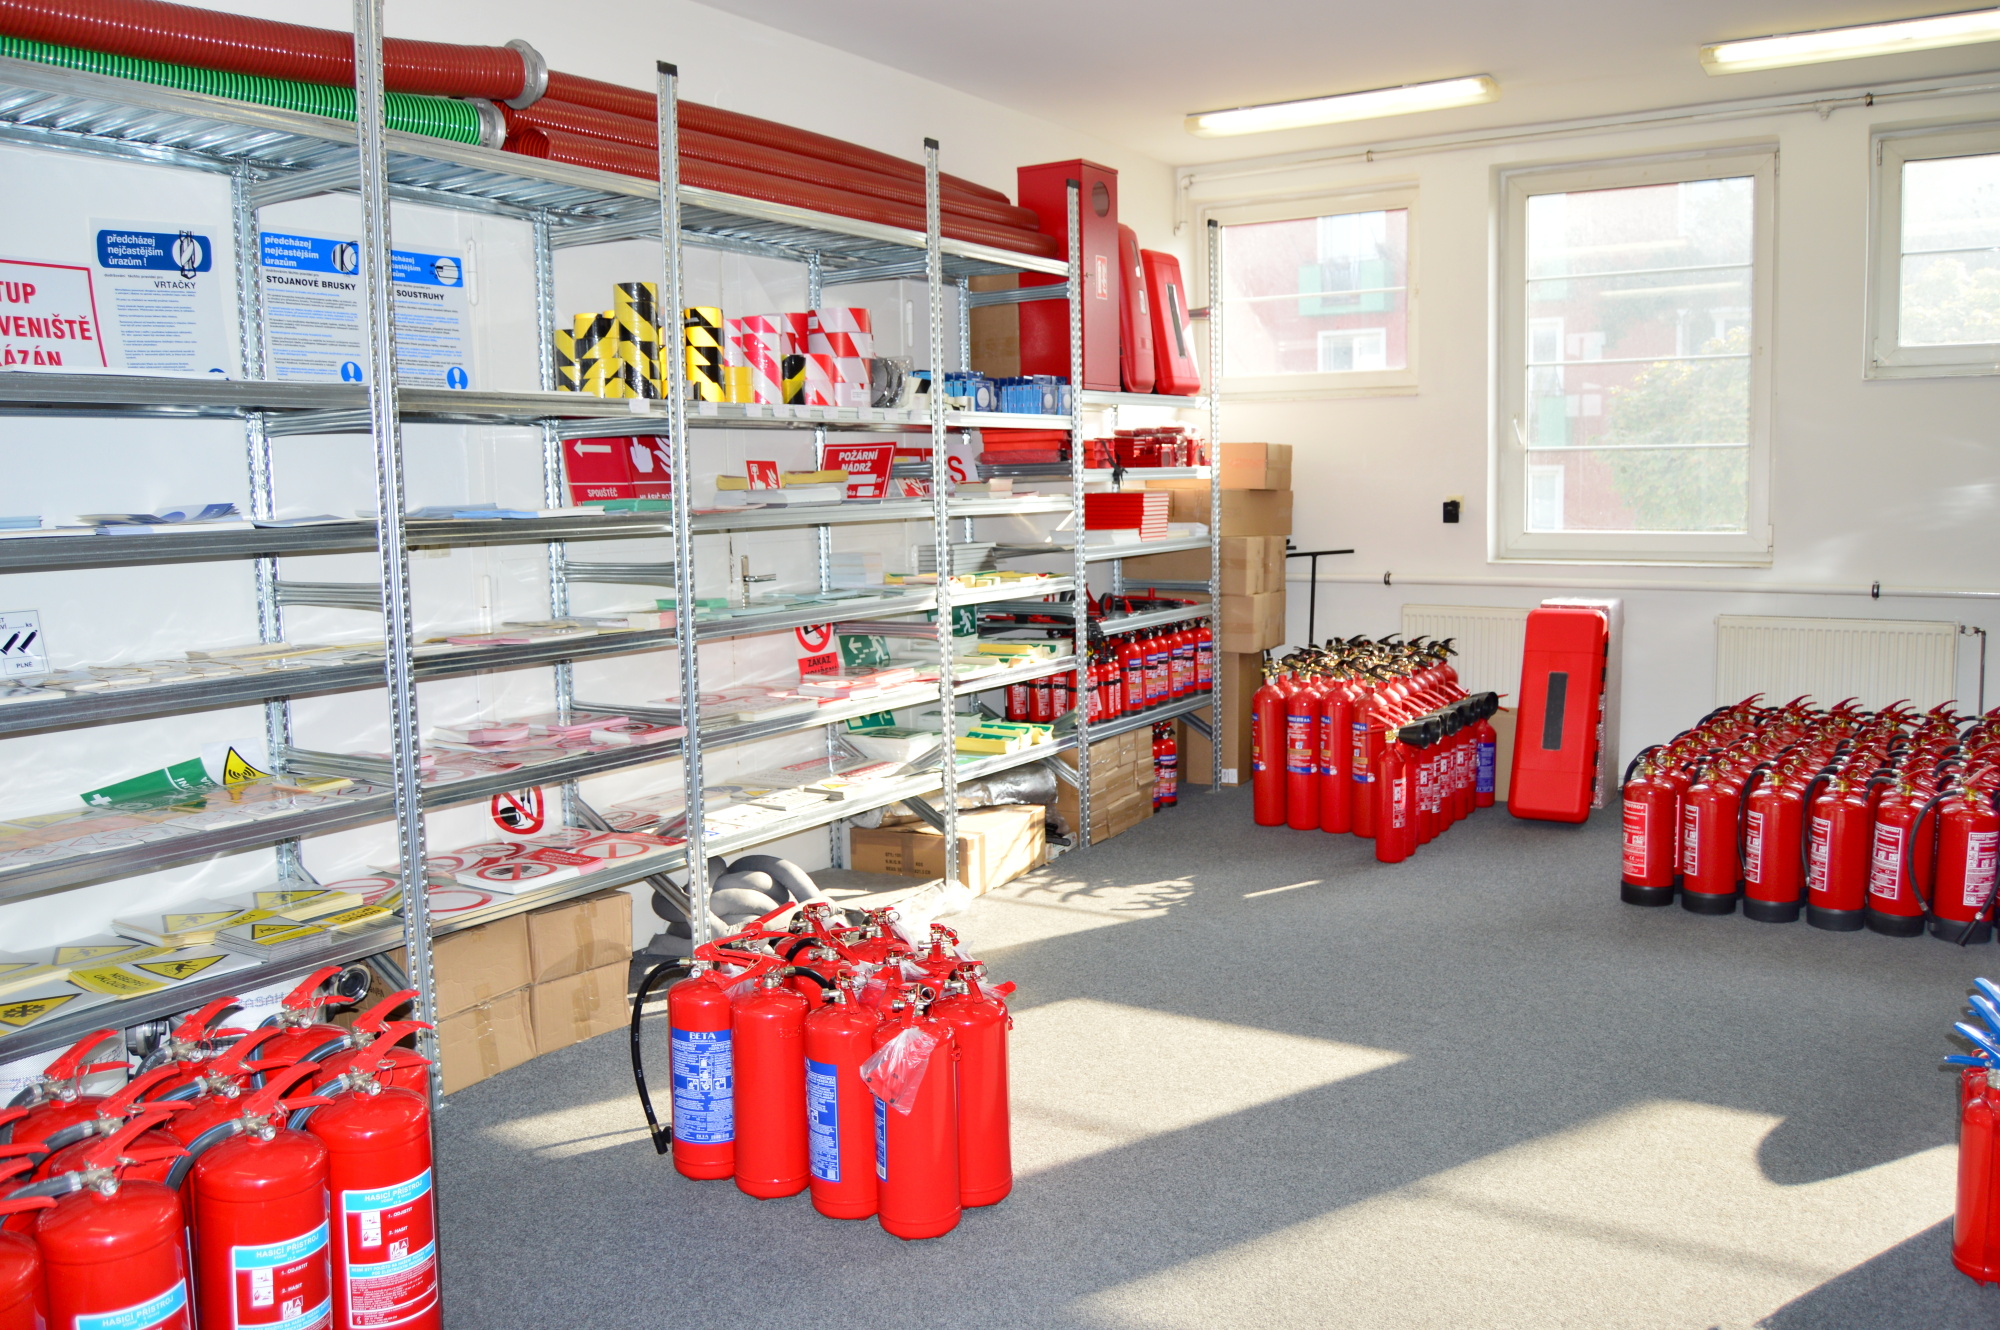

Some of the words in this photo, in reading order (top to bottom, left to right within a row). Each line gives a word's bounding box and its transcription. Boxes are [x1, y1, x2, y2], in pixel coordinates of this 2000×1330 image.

[107, 234, 155, 246] předcházej
[264, 235, 312, 249] předcházej
[107, 245, 164, 257] nejčastějším
[264, 247, 319, 259] nejčastějším
[108, 257, 142, 266] úrazům
[265, 256, 297, 267] úrazům
[153, 279, 197, 289] VRTAČKY
[266, 275, 319, 288] STOJANOVÉ
[321, 280, 356, 291] BRUSKY
[396, 289, 445, 300] SOUSTRUHY
[838, 449, 879, 461] POŽÁRNÍ
[841, 461, 872, 472] NÁDRŽ
[587, 487, 618, 498] SPOUŠTĚČ
[807, 655, 831, 667] ZÁKAZ
[689, 1031, 716, 1040] BETA
[364, 1190, 391, 1202] HASICÍ
[393, 1180, 423, 1196] PŘÍSTROJ
[256, 1247, 285, 1258] HASICÍ
[286, 1233, 319, 1252] PŘÍSTROJ
[102, 1312, 134, 1327] HASICÍ
[136, 1295, 174, 1319] PŘÍSTROJ
